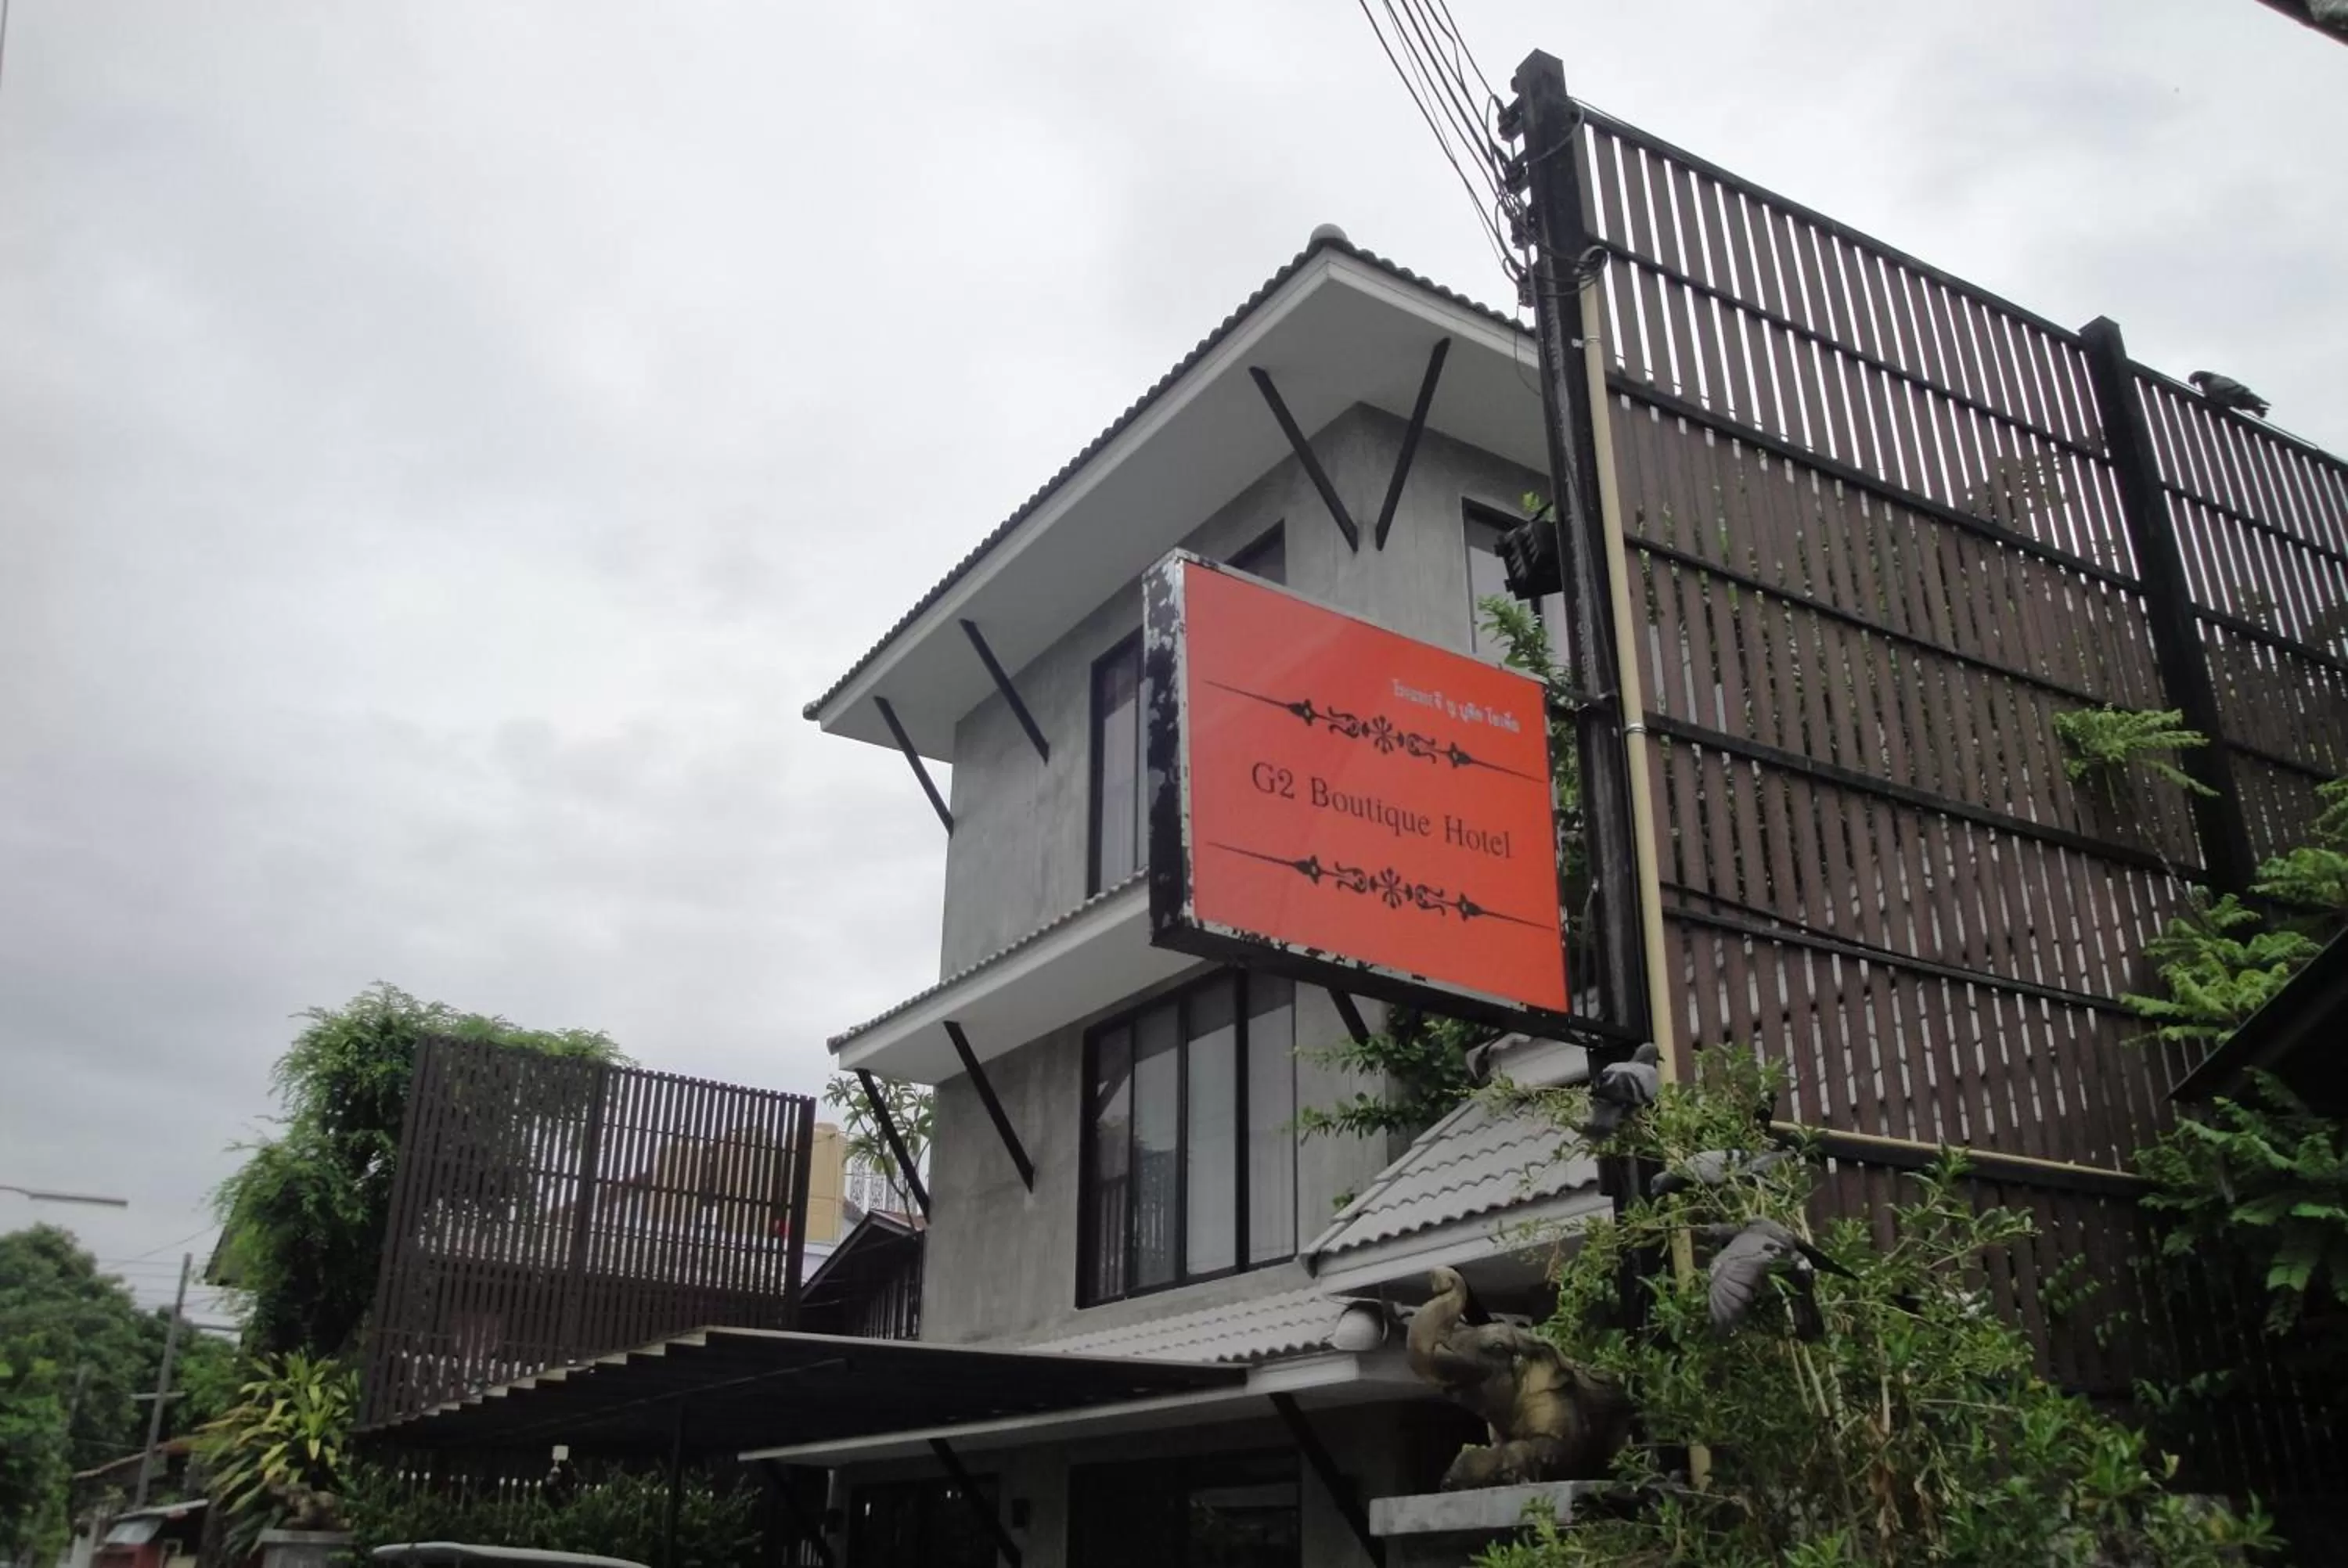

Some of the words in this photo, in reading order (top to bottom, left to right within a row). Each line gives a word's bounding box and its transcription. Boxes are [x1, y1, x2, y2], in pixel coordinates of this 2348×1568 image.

[1251, 761, 1295, 800] G2
[1310, 776, 1431, 837] Boutique
[1445, 815, 1511, 858] Hotel
